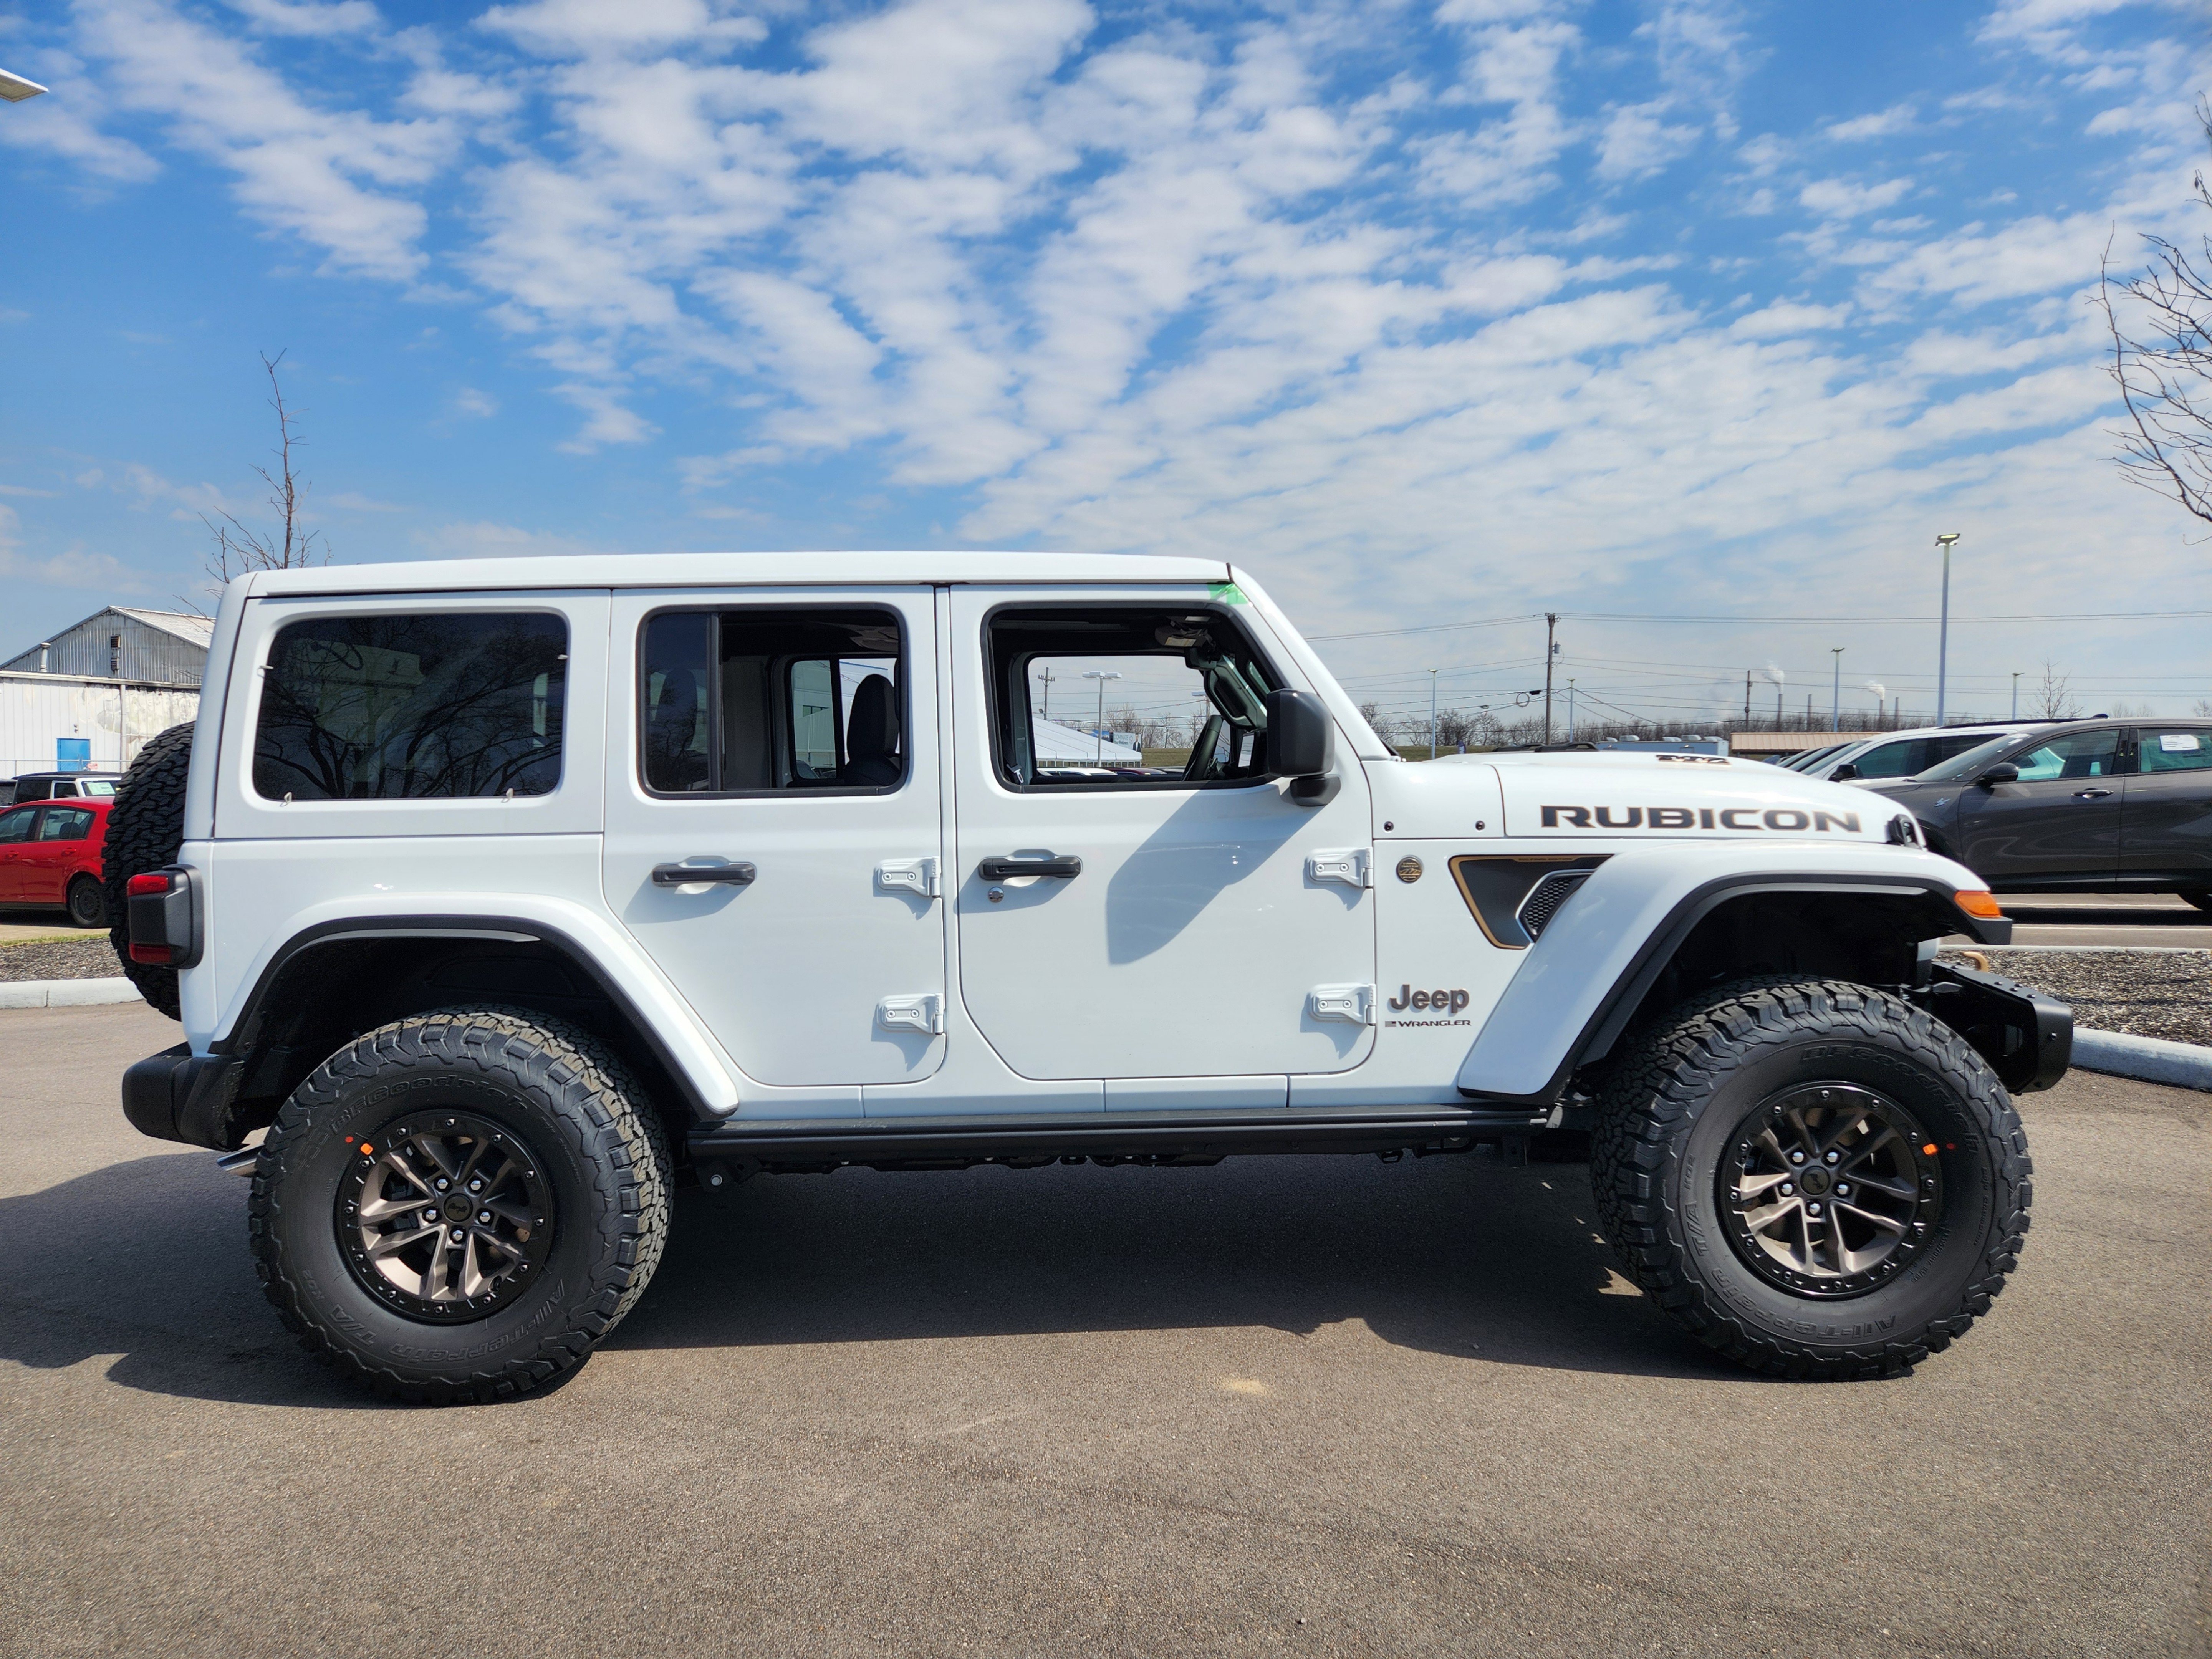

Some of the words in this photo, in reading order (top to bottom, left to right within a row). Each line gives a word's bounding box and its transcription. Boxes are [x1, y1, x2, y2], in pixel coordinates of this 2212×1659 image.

[1540, 805, 1863, 833] RUBICON
[1389, 984, 1470, 1013] Jeep
[329, 1075, 528, 1135] BFGoodrich
[1802, 1044, 1979, 1152] BFGoodrich
[1685, 1200, 1709, 1257] T/A
[329, 1304, 377, 1347] T/A
[388, 1279, 565, 1364] All-Terrain
[1711, 1268, 1896, 1339] All-Terrain
